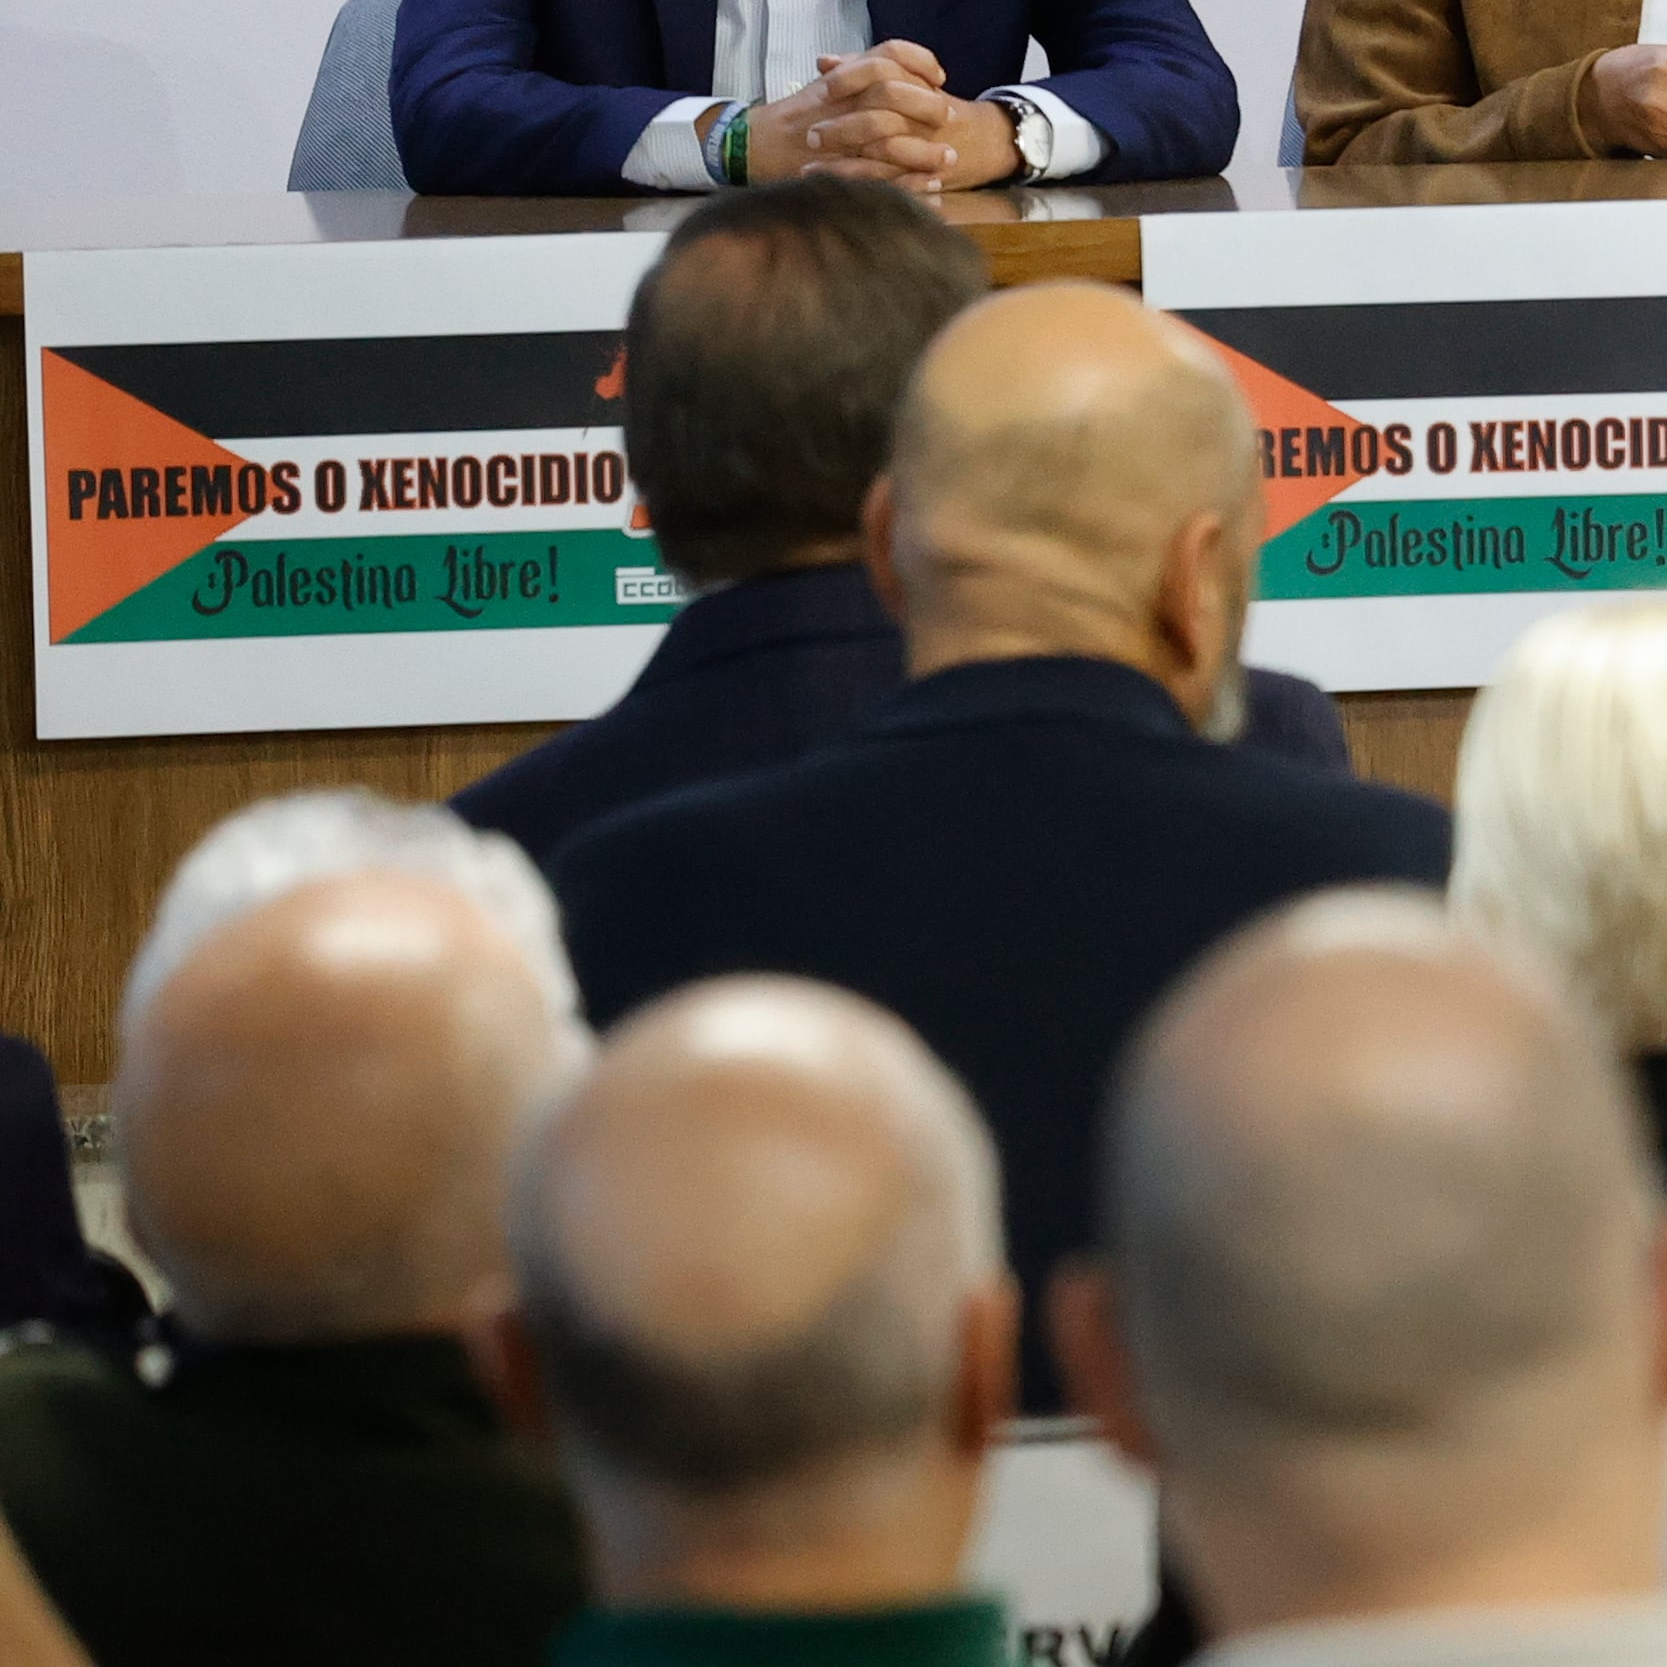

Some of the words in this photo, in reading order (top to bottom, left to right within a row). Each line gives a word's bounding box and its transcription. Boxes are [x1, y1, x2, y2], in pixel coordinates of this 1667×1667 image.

[1426, 420, 1458, 475] O
[67, 459, 302, 521] PAREMOS
[313, 458, 347, 514] O
[1305, 508, 1526, 577] Palestina
[1544, 506, 1667, 580] Libre!
[191, 548, 417, 617] Palestina
[435, 543, 560, 619] Libre!
